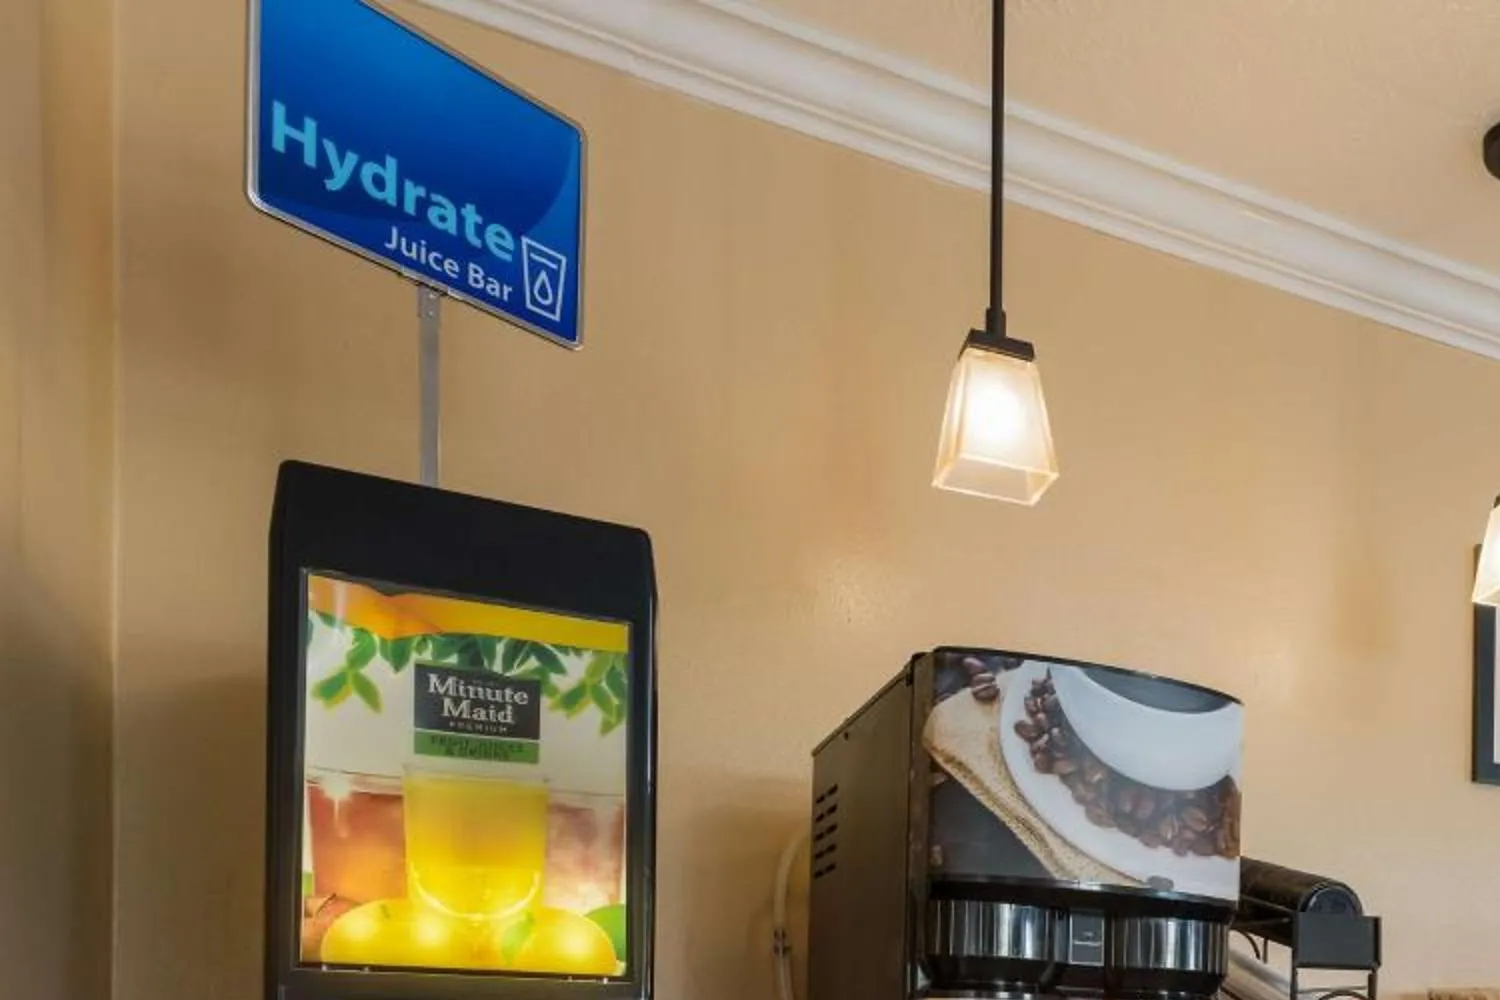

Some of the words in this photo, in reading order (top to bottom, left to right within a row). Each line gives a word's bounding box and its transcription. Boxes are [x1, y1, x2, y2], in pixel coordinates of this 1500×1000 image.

[271, 99, 515, 262] Hydrate
[384, 226, 460, 279] Juice
[467, 261, 513, 302] Bar
[427, 672, 529, 706] Minute
[441, 697, 516, 725] Maid
